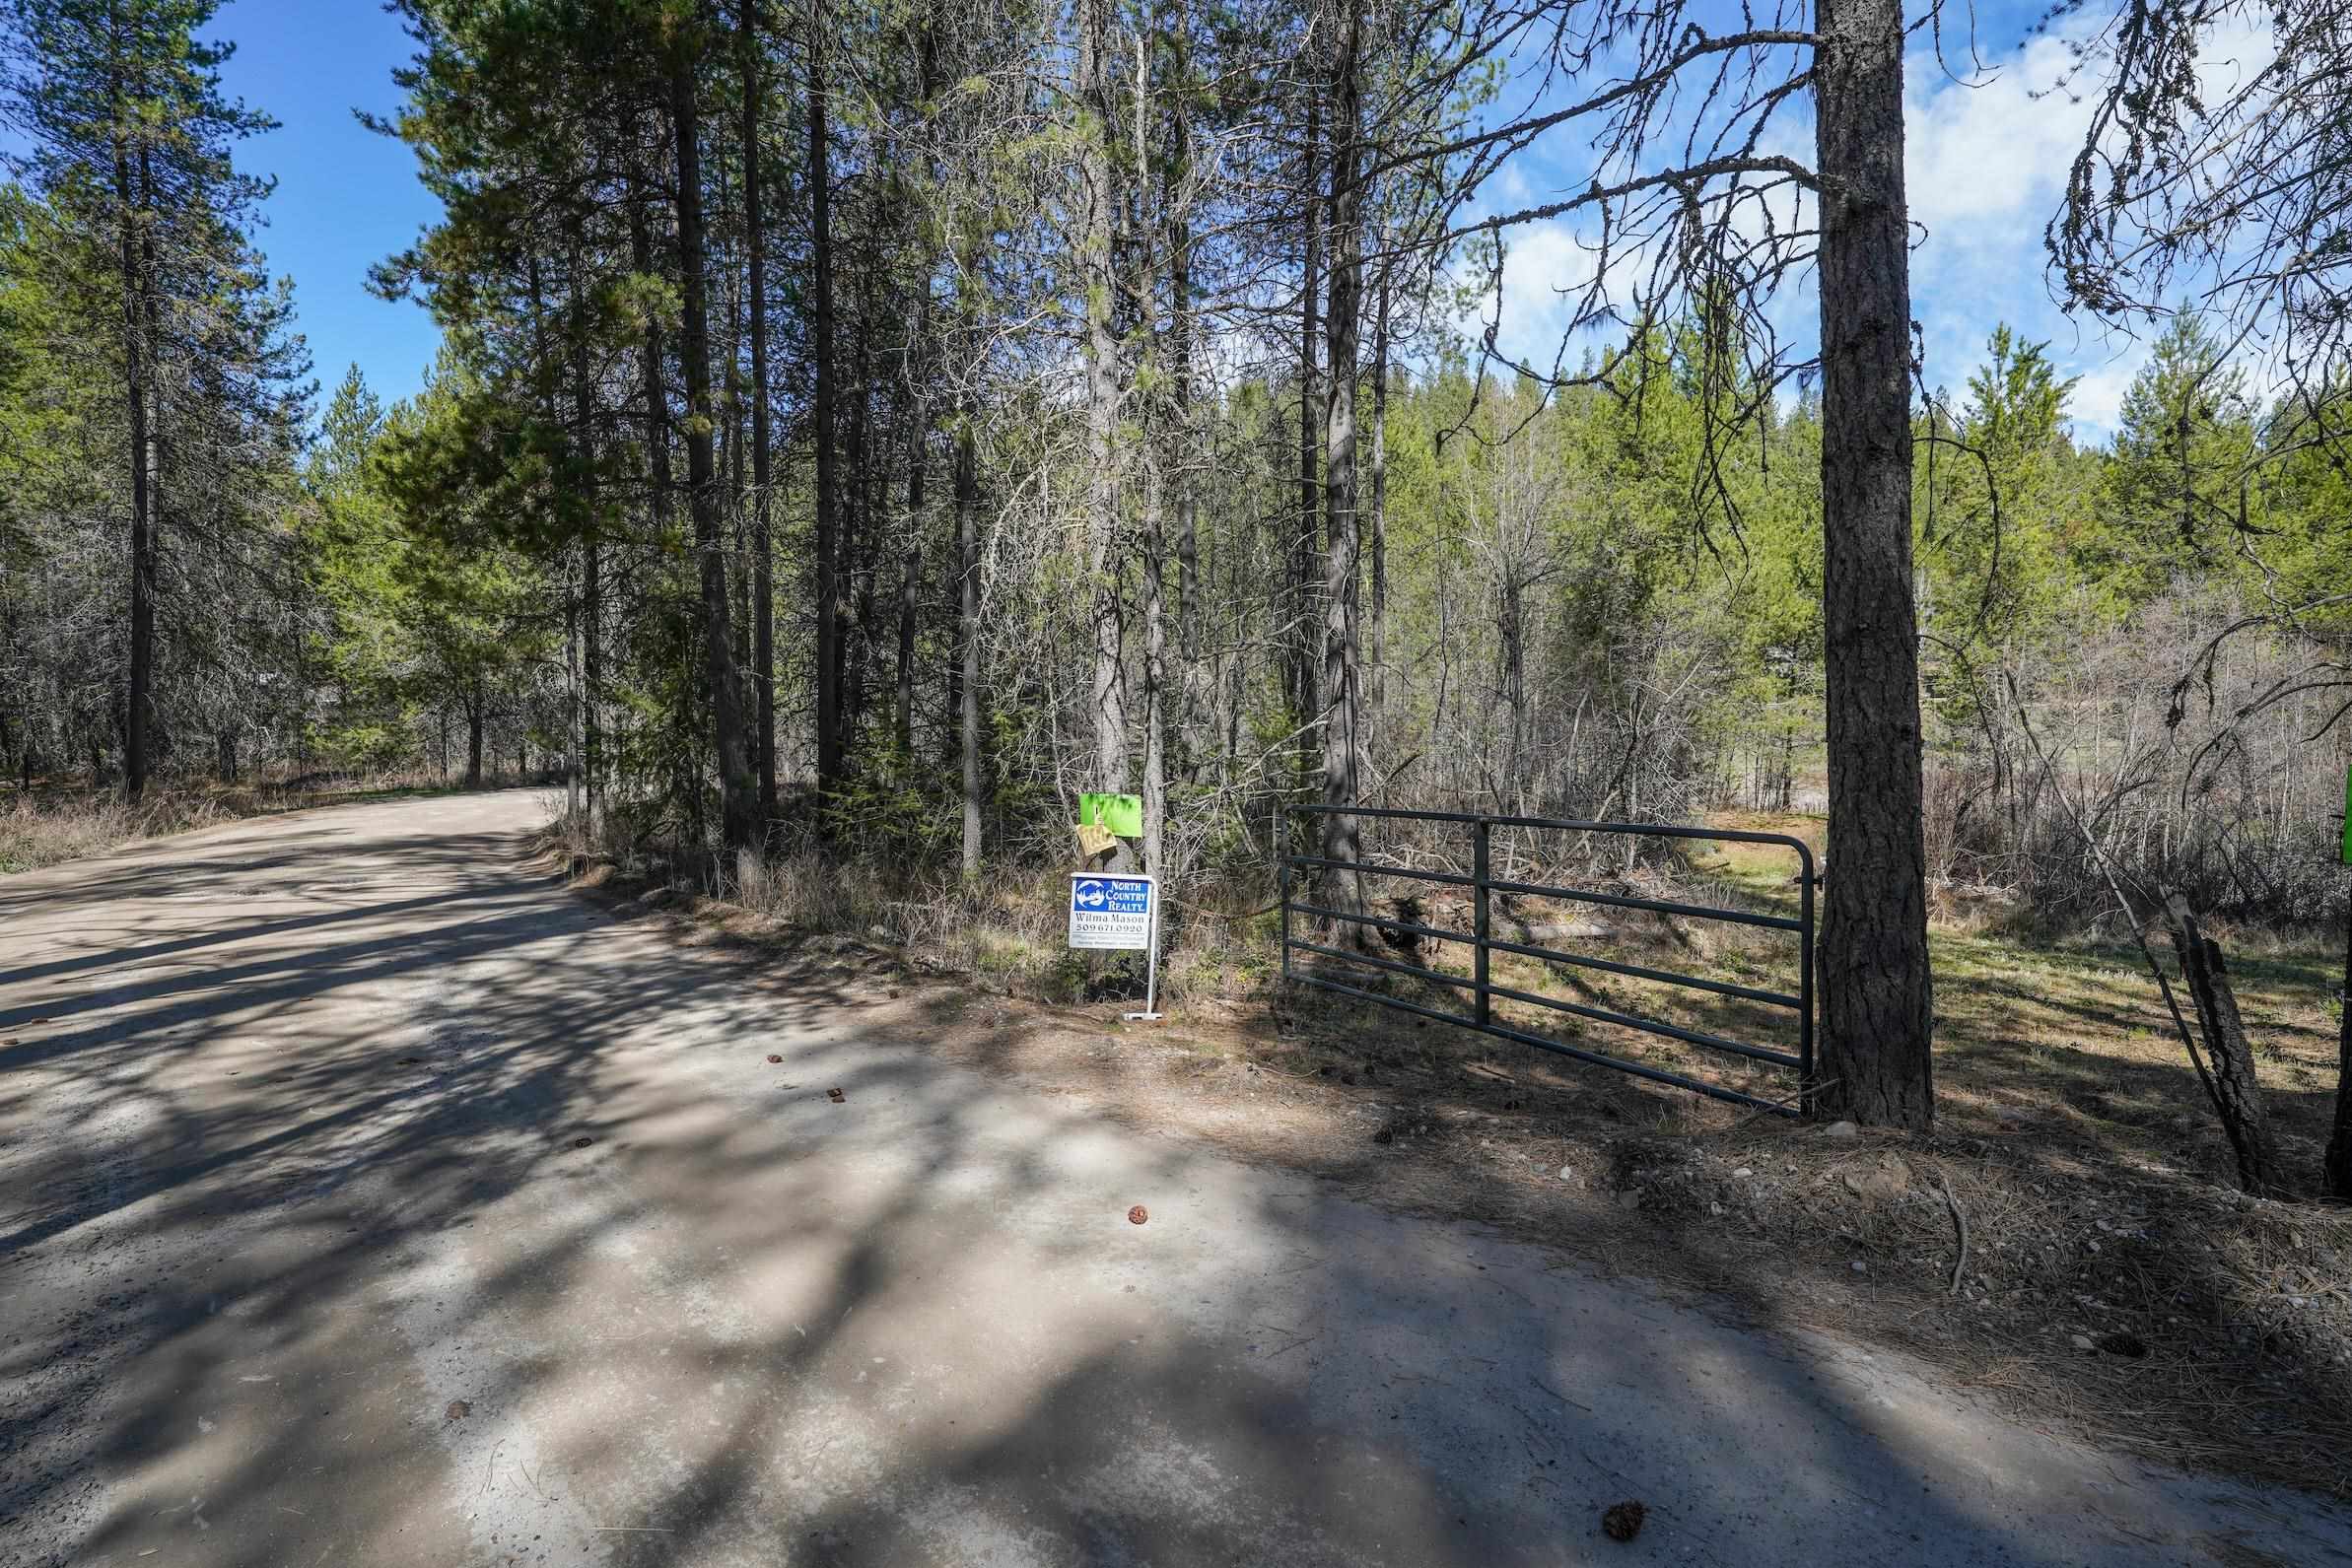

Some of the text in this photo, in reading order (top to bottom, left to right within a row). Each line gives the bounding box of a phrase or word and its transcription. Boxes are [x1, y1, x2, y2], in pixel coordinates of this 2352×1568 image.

[1111, 880, 1141, 892] NORTH
[1105, 890, 1146, 902] COUNTRY
[1075, 912, 1144, 923] Wilma Mason
